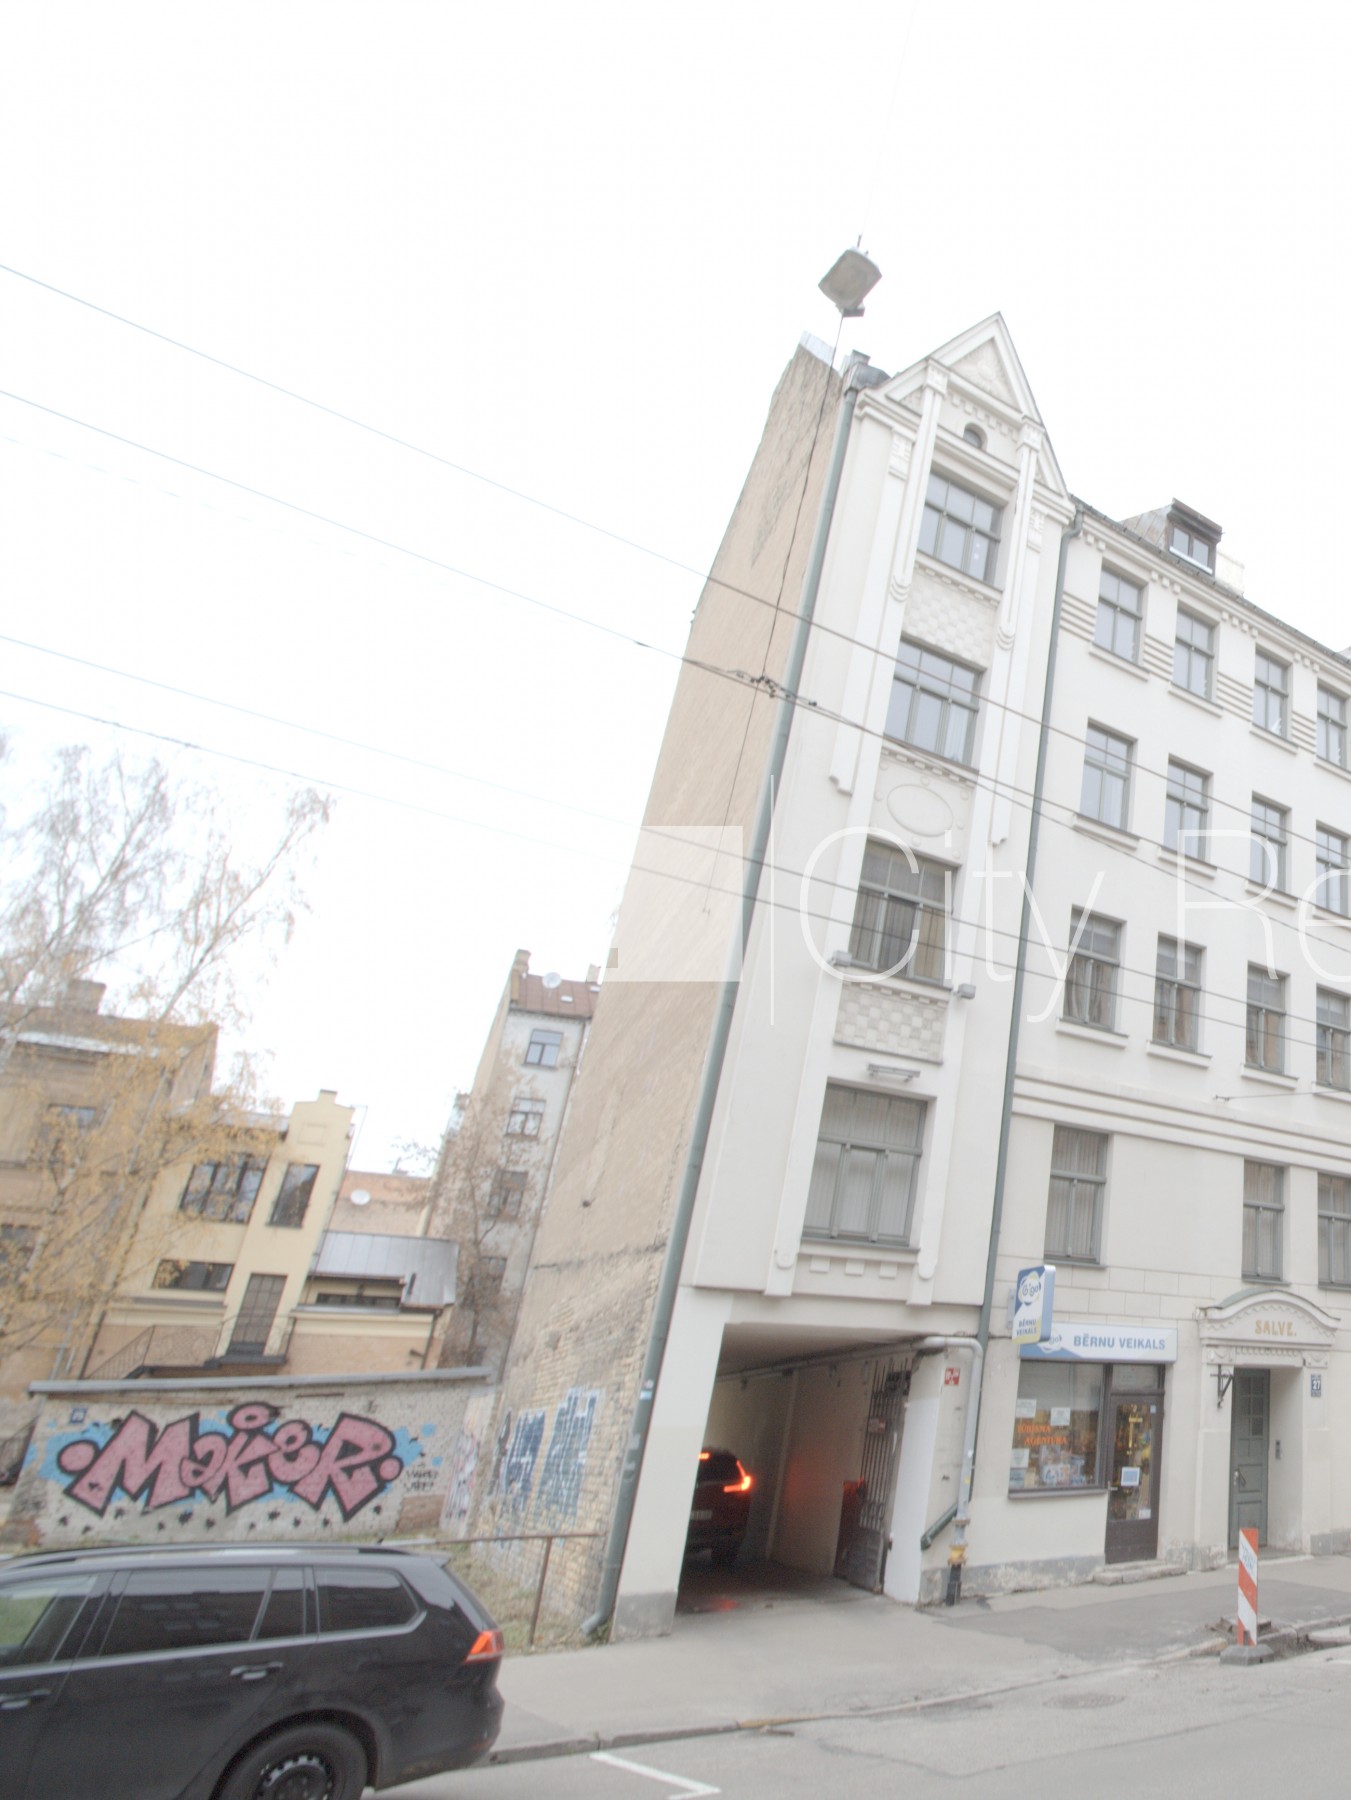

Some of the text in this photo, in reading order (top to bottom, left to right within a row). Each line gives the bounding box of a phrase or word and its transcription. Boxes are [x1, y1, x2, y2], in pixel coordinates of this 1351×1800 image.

[1016, 1327, 1037, 1337] VEIKALS
[1073, 1333, 1166, 1350] BĒRNU VEIKALS
[1313, 1380, 1321, 1390] 27
